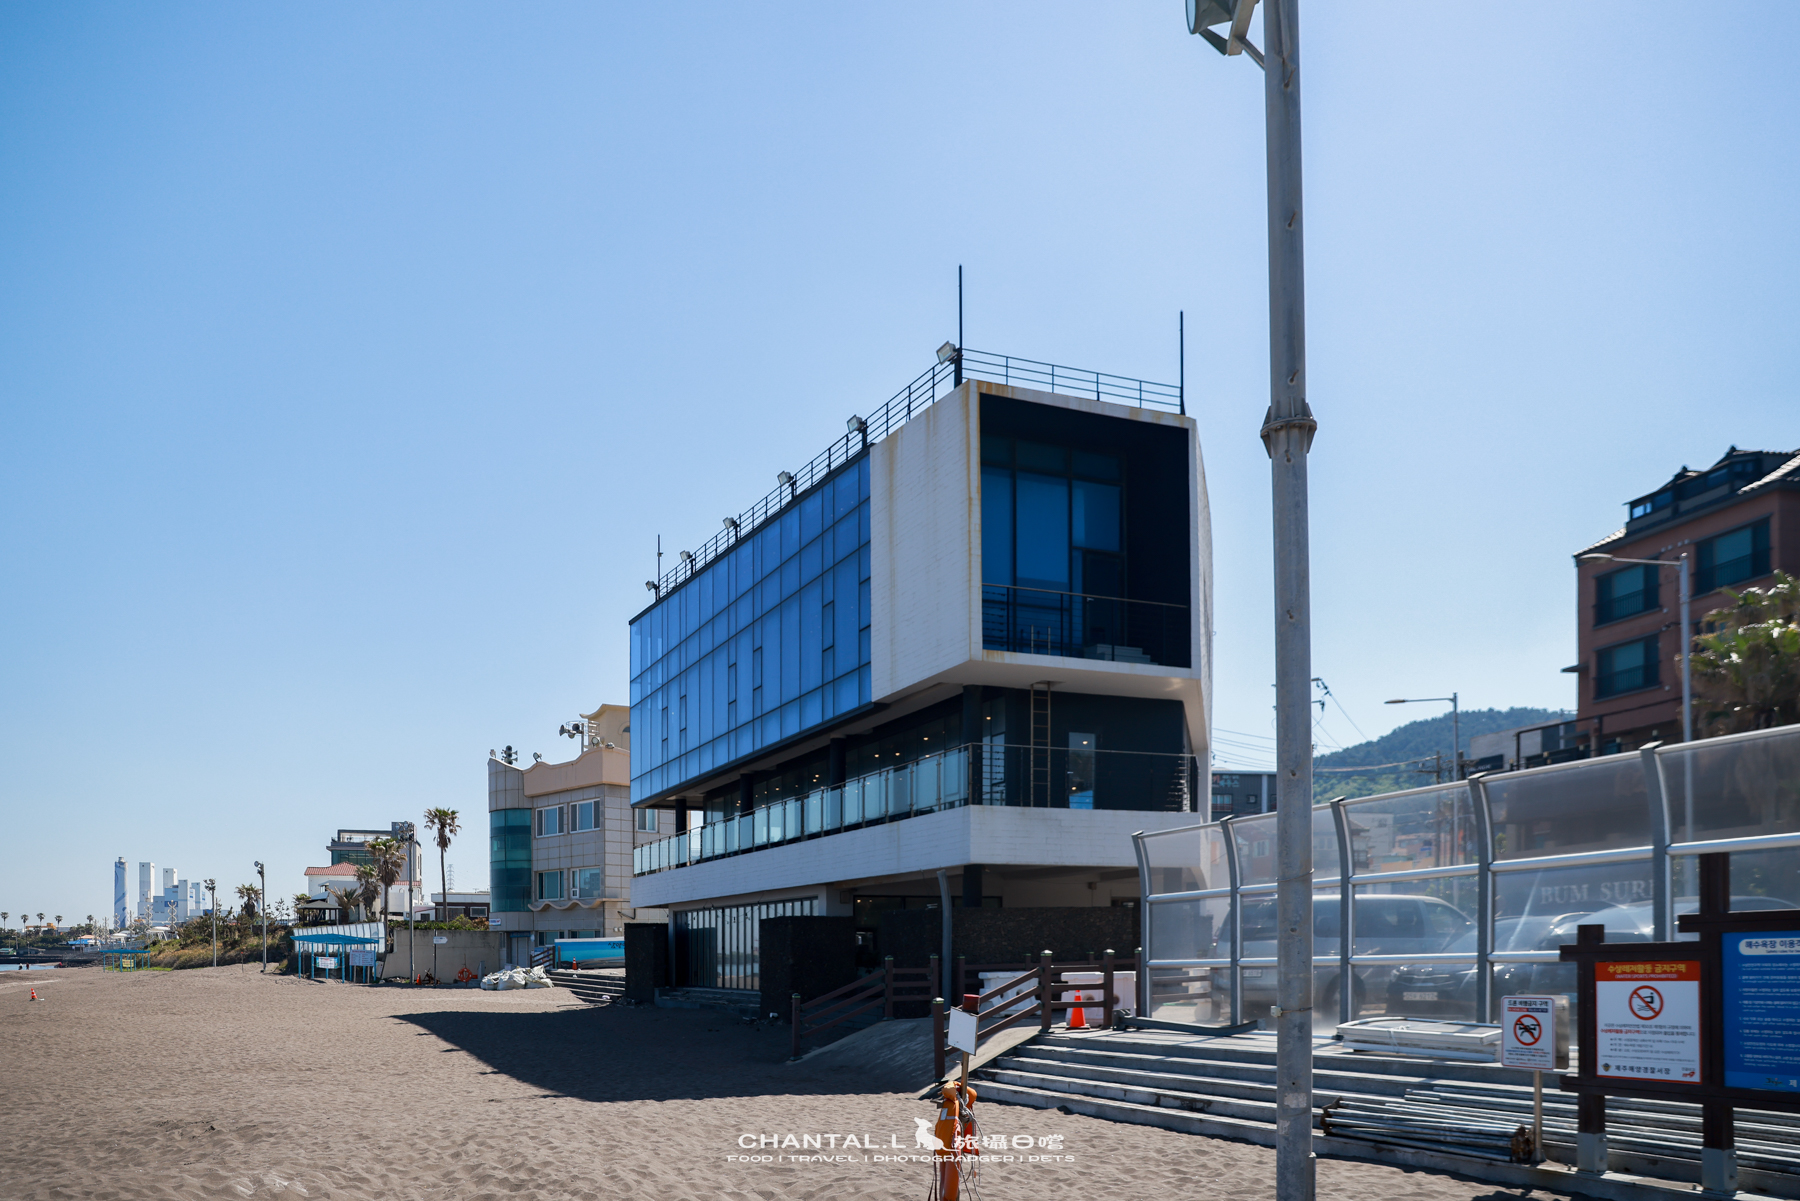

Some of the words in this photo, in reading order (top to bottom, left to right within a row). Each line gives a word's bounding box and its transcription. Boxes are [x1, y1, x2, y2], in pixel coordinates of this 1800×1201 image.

[1541, 884, 1589, 904] BUM
[1745, 940, 1777, 949] 해수욕장
[1654, 964, 1687, 973] 금지구역
[1614, 1064, 1671, 1076] 제주해양경찰서장
